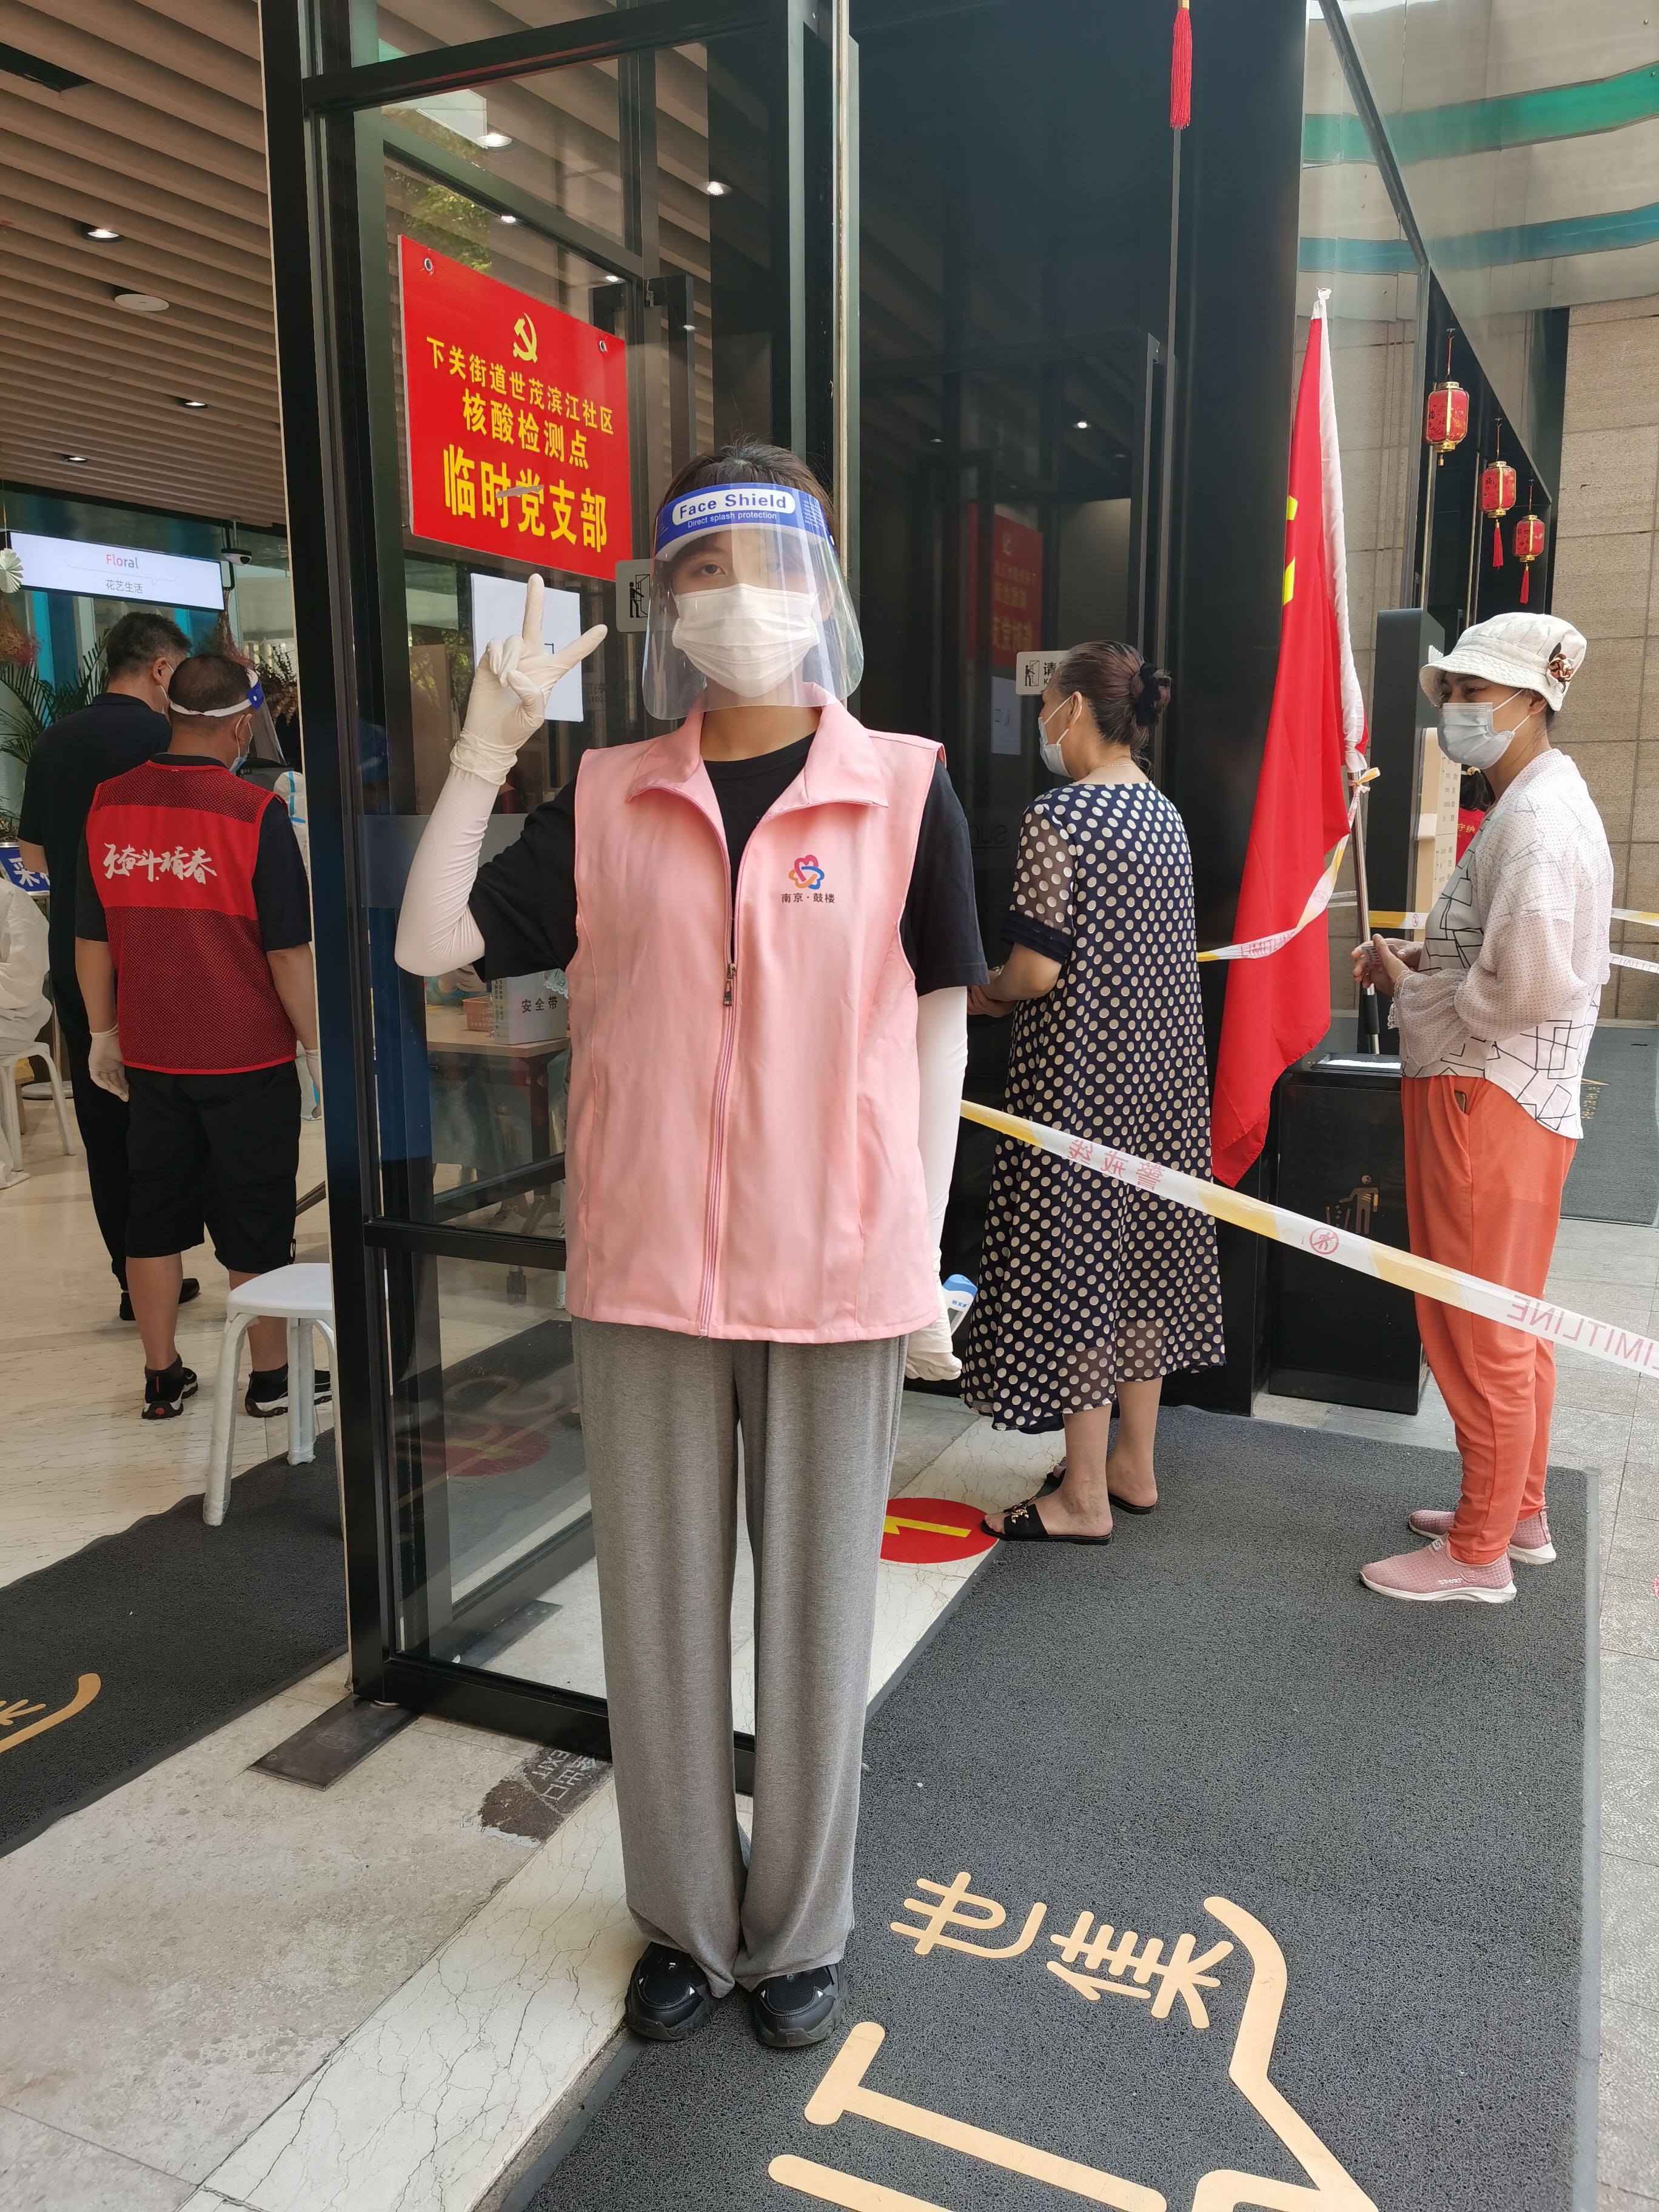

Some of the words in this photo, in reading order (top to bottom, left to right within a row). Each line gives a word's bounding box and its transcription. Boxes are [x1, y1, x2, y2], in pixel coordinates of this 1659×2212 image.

[426, 337, 614, 435] 下关街道世茂滨江社区
[463, 388, 589, 469] 核酸检测点
[443, 444, 608, 552] 临时党支部
[680, 500, 717, 520] Face
[725, 493, 786, 509] Shield
[688, 517, 708, 528] Direct
[710, 512, 735, 523] splash
[738, 511, 777, 520] protection
[106, 554, 139, 569] Floral
[106, 578, 143, 594] 花艺生活
[521, 996, 558, 1013] 安全带
[531, 1749, 571, 1780] EXIT
